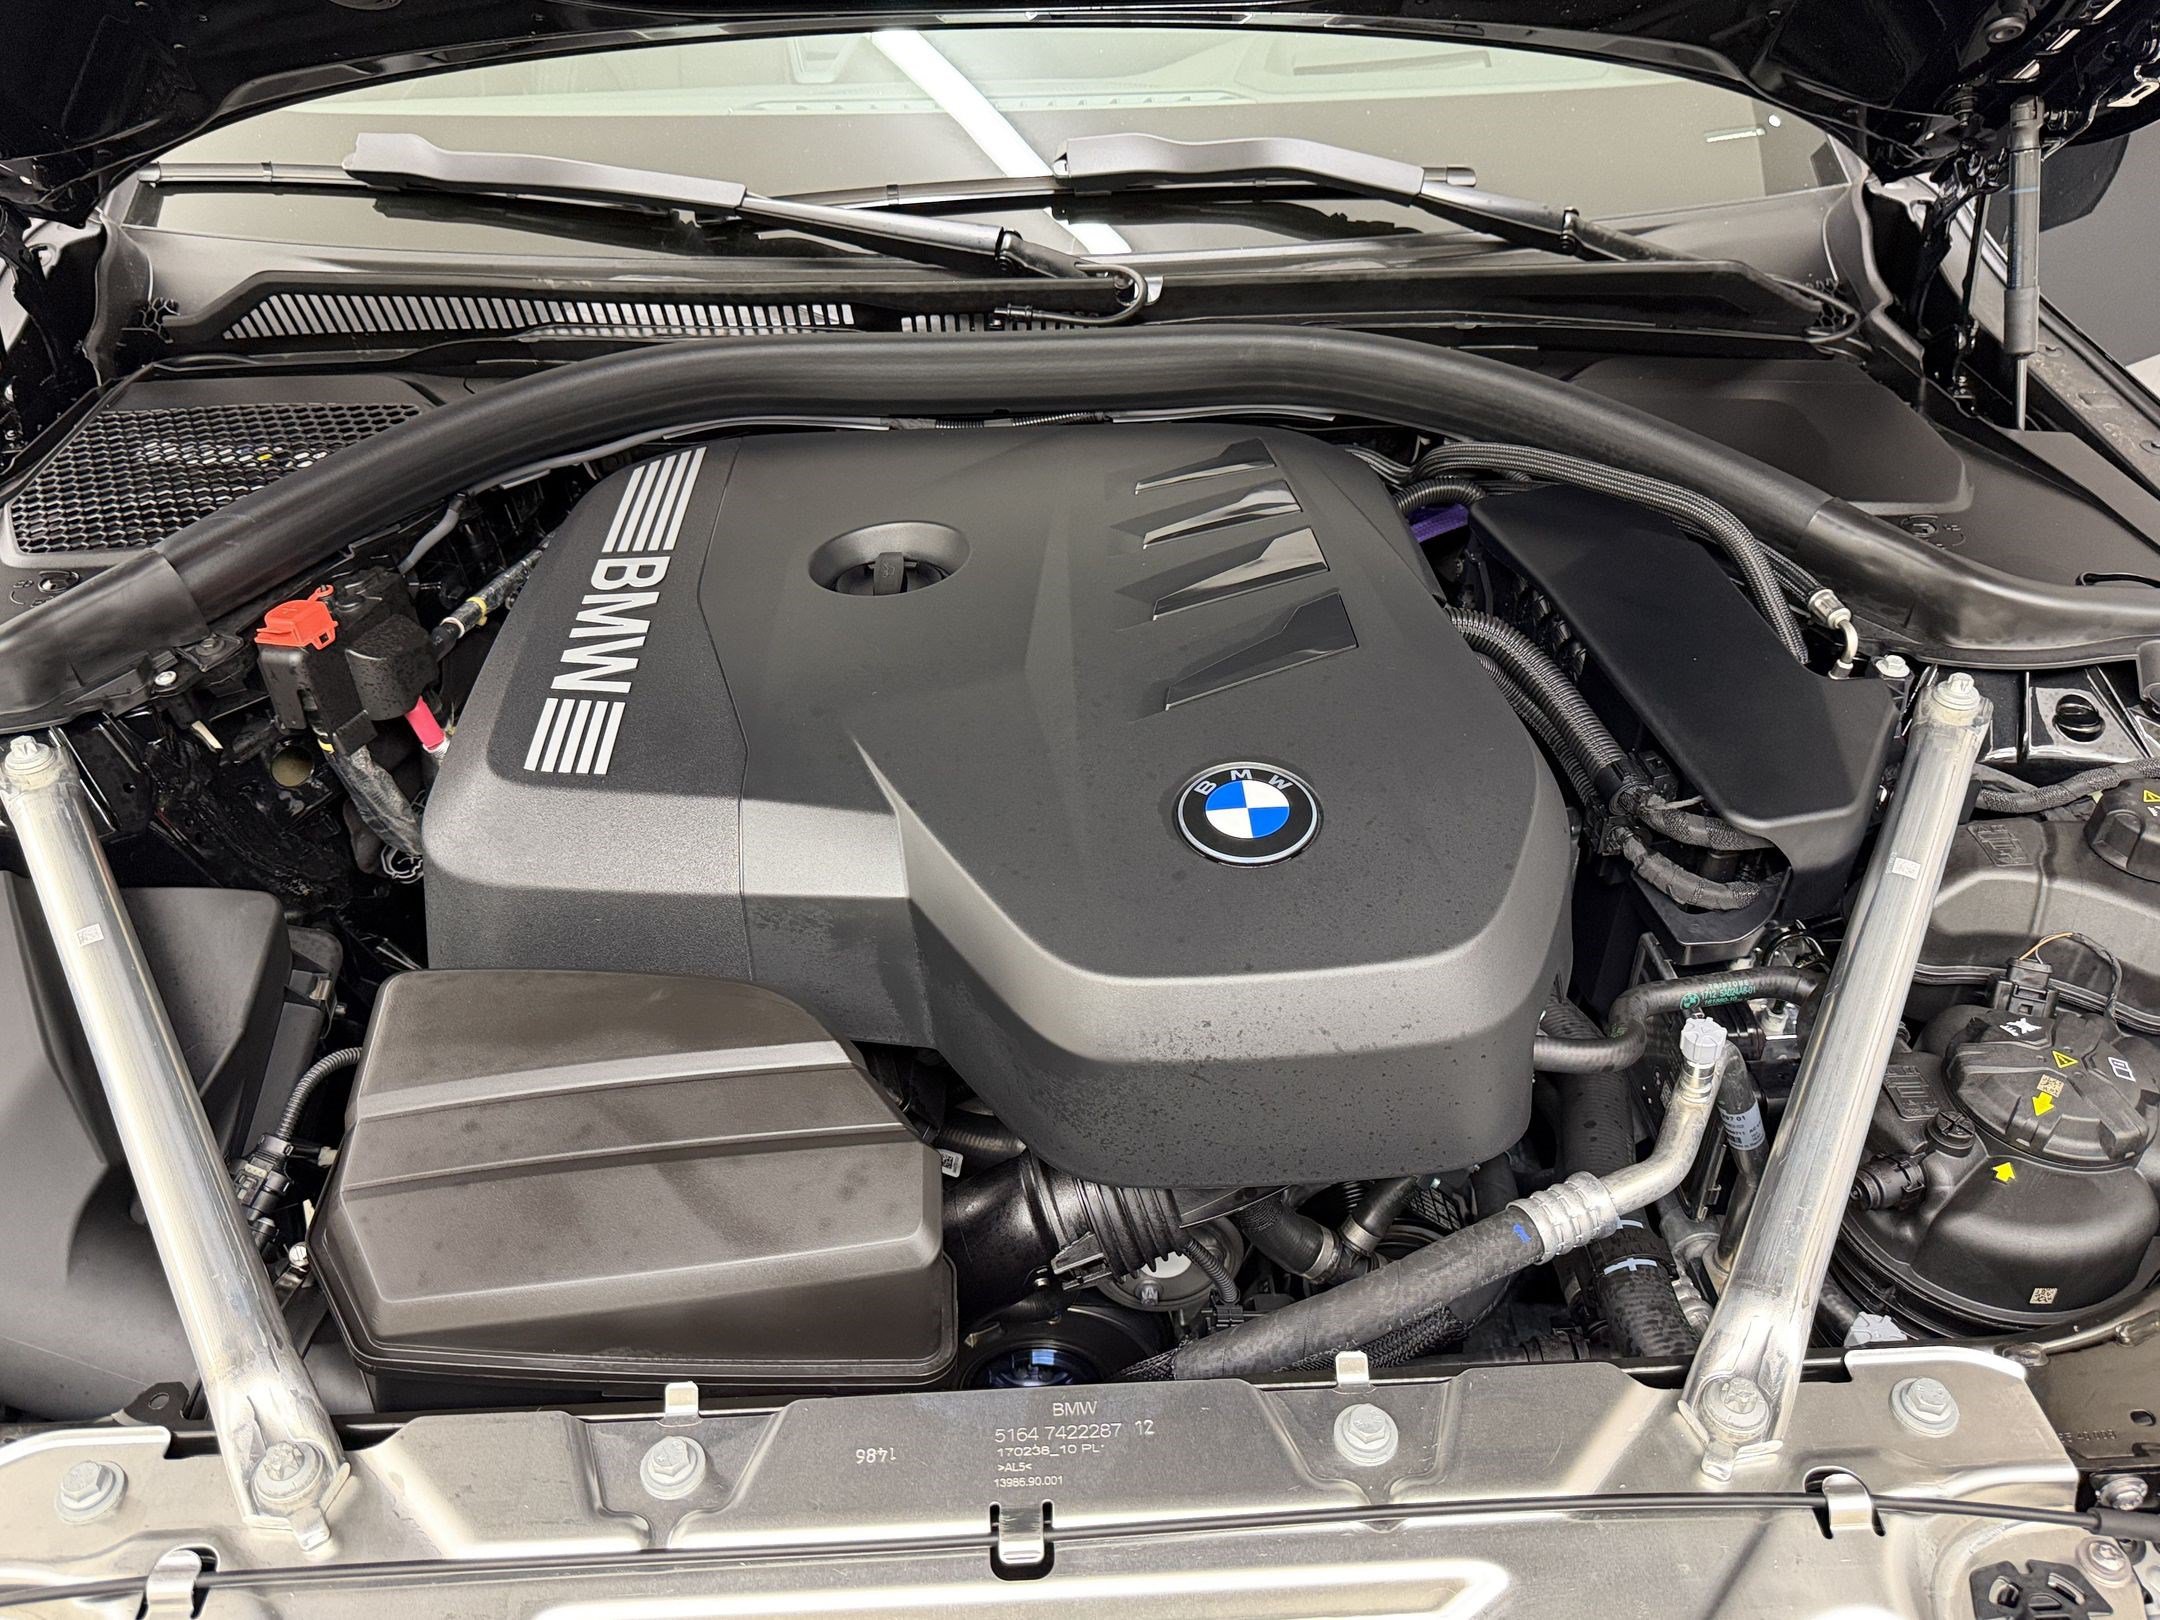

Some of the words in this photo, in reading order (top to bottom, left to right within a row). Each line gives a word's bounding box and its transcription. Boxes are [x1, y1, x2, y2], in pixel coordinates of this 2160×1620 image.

[550, 556, 671, 694] BMW
[1194, 769, 1294, 796] BMW
[1052, 1401, 1099, 1417] BMW
[994, 1427, 1040, 1443] 5164
[1044, 1422, 1122, 1440] 7422287
[1134, 1419, 1156, 1436] 12
